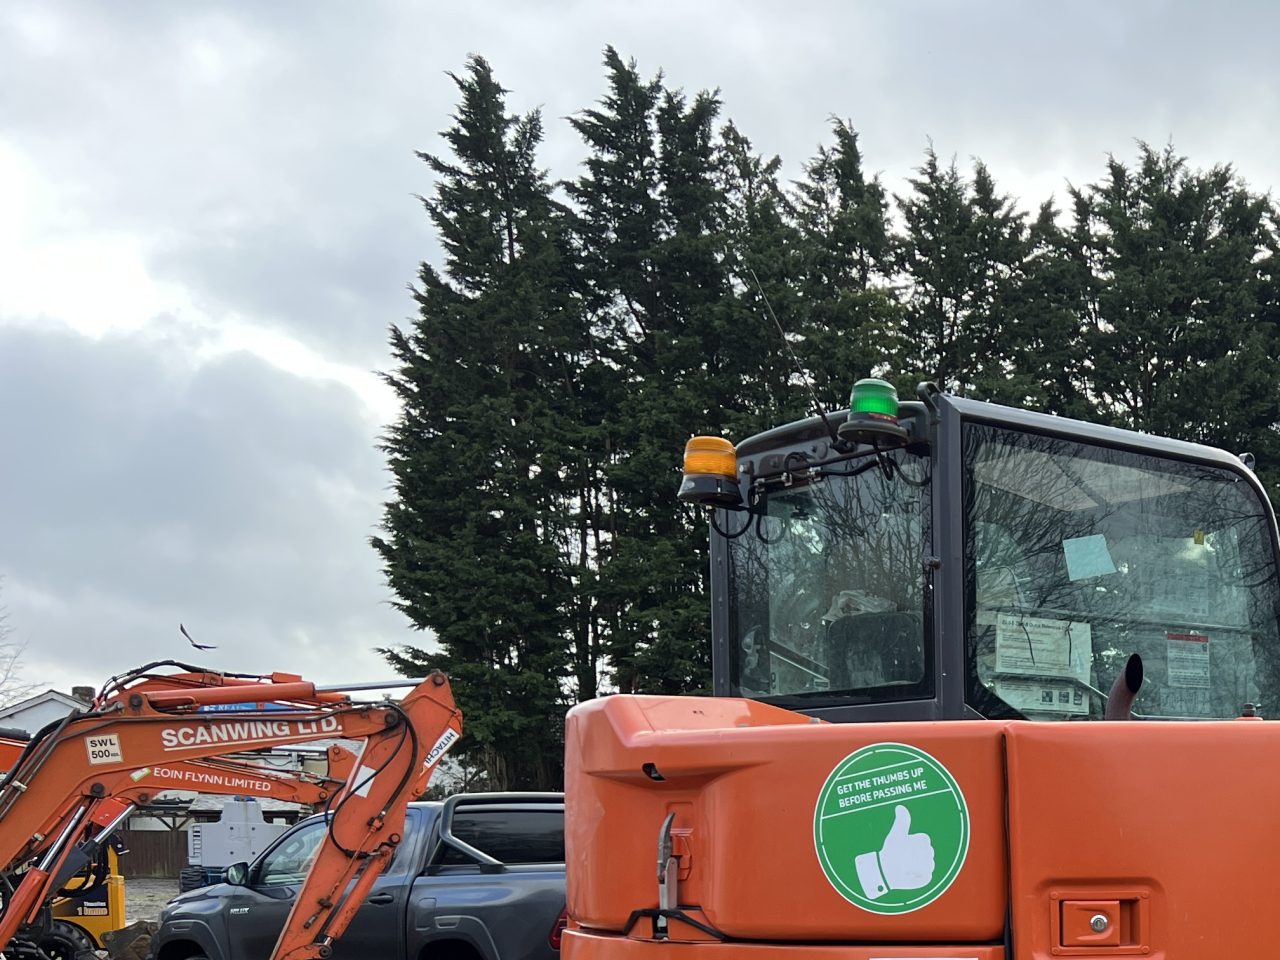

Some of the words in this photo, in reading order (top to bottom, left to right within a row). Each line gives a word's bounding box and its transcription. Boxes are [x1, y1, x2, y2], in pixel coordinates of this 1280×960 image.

[90, 739, 116, 748] SWL
[161, 721, 291, 747] SCANWING
[91, 749, 111, 759] 500
[425, 732, 456, 764] HITACHI
[153, 767, 183, 780] EOIN
[185, 771, 223, 786] FLYNN
[225, 777, 271, 791] LIMITED
[837, 783, 853, 795] GET
[854, 779, 872, 790] THE
[872, 770, 910, 786] THUMBS
[911, 767, 924, 778] UP
[838, 792, 873, 808] BEFORE
[873, 783, 912, 800] PASSING
[913, 780, 928, 791] ME
